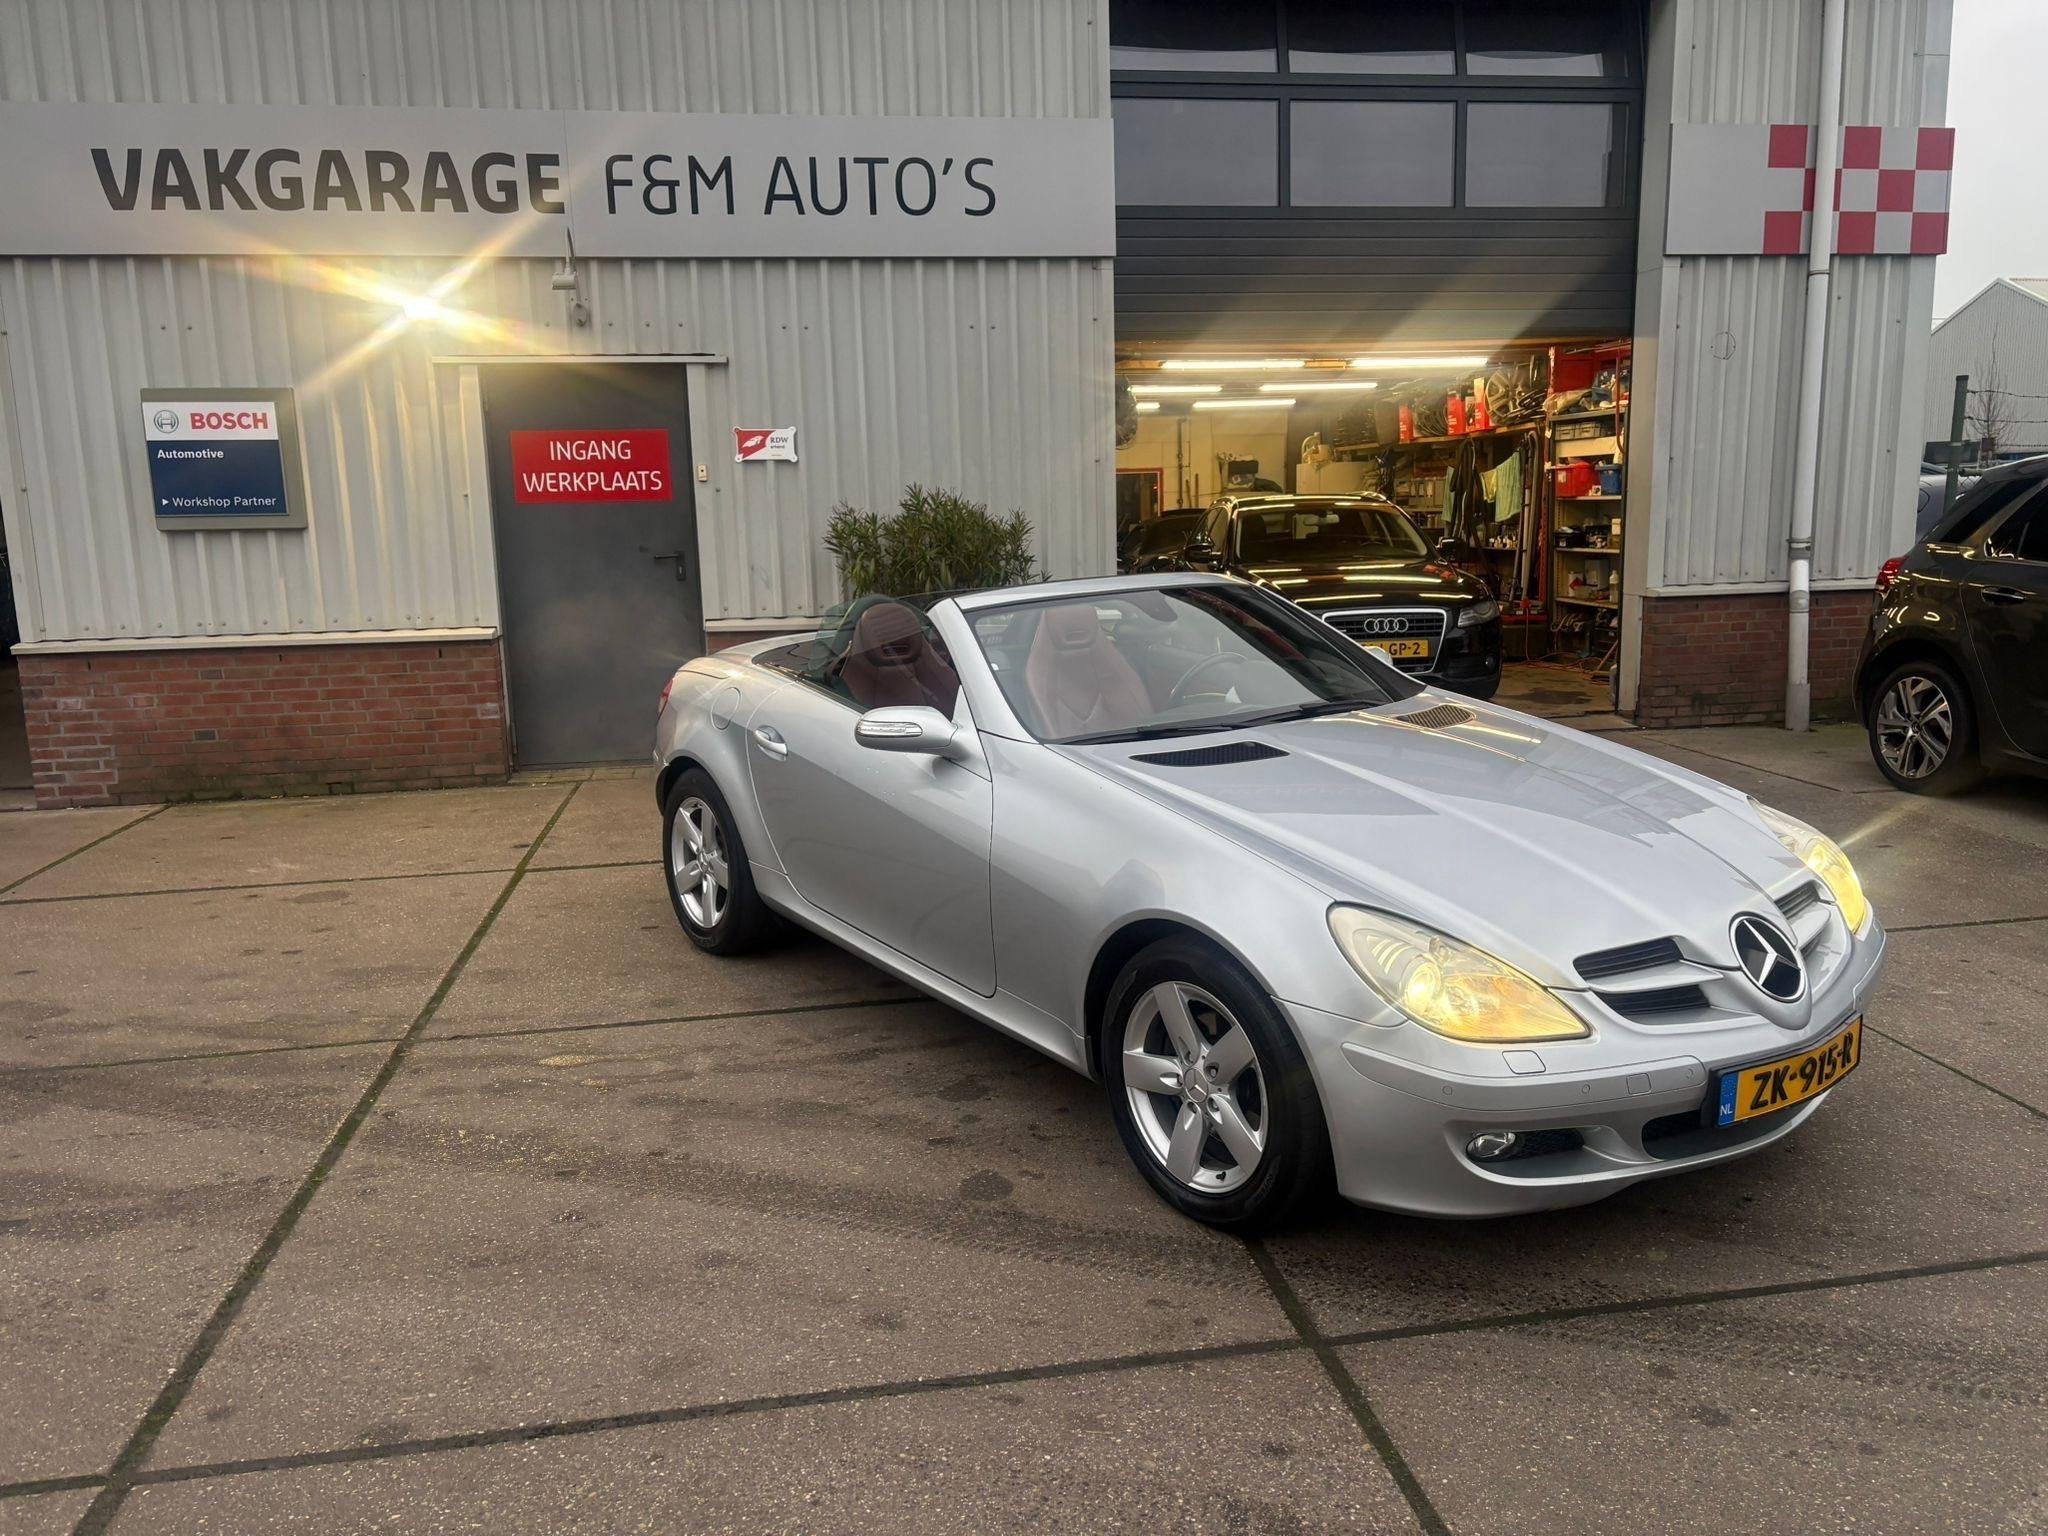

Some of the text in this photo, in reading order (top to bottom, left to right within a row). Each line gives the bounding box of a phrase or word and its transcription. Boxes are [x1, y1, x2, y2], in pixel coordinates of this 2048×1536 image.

[90, 147, 997, 217] VAKGARAGE F&M AUTO'S
[190, 412, 269, 430] BOSCH
[157, 449, 225, 460] Automotive
[550, 440, 632, 461] INGANG
[522, 470, 663, 493] WERKPLAATS
[172, 496, 277, 508] Workshop Partner
[1750, 1030, 1854, 1111] ZK-915-R
[1719, 1103, 1733, 1116] NL
